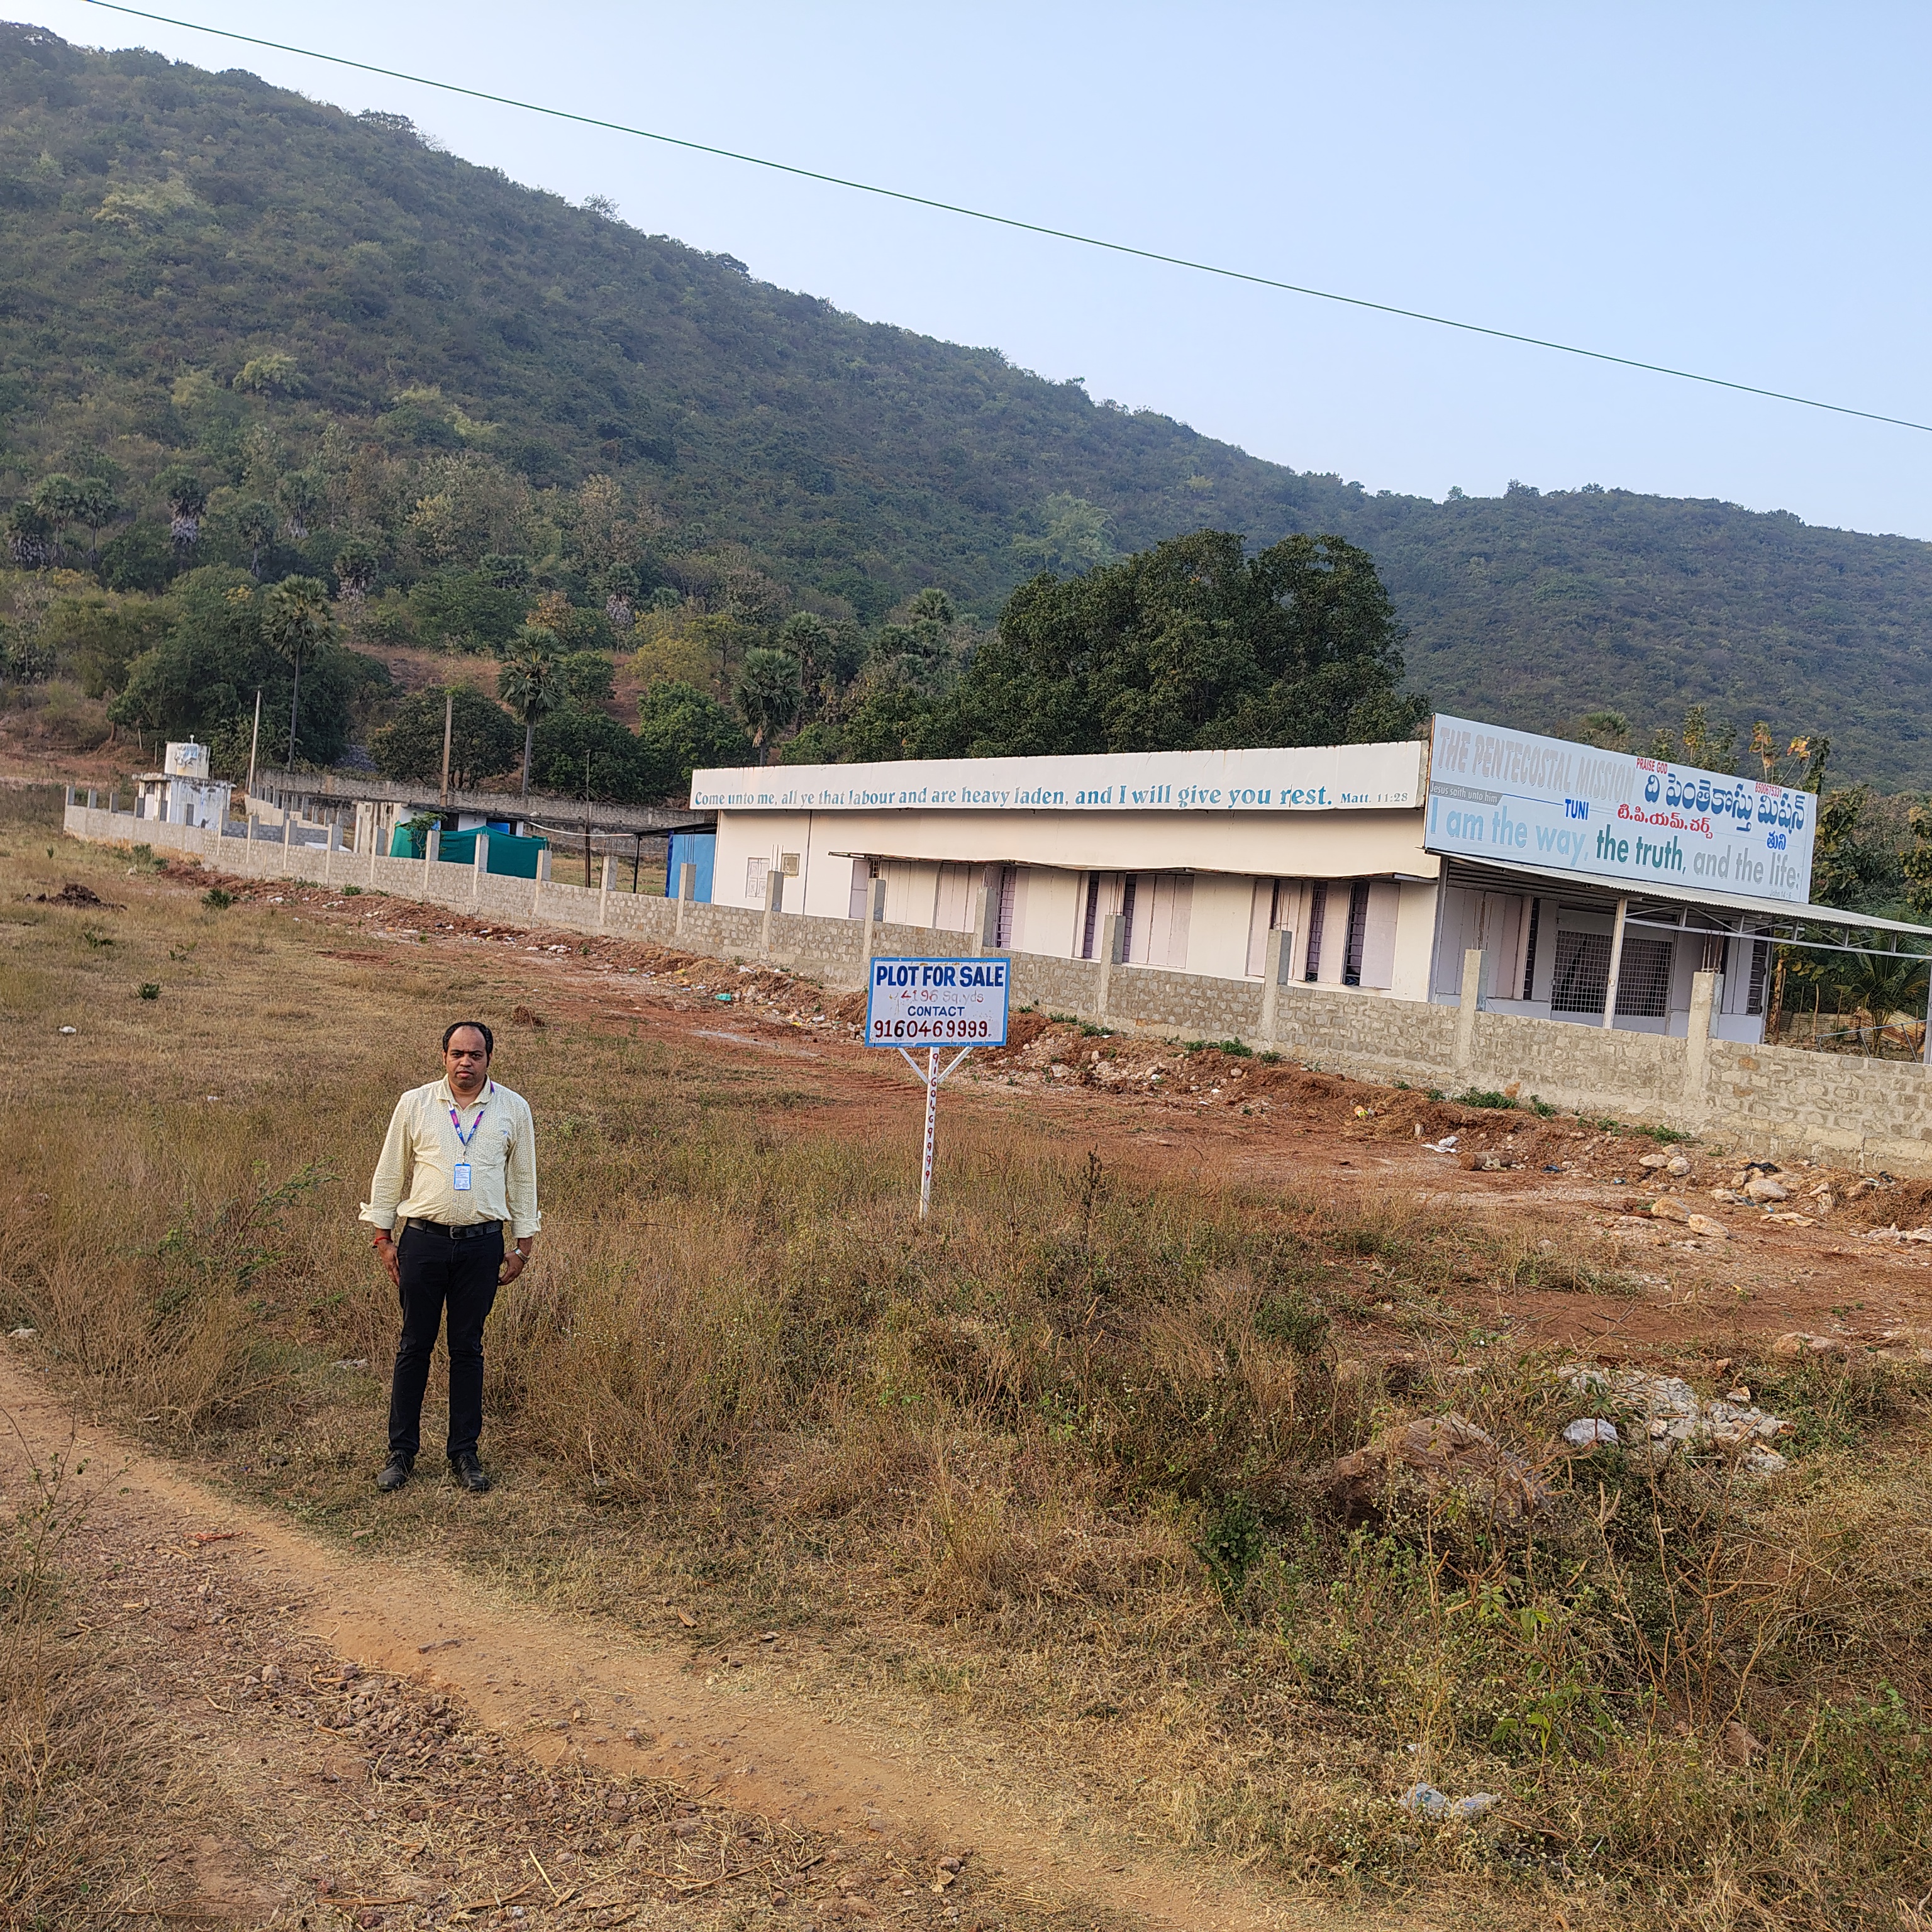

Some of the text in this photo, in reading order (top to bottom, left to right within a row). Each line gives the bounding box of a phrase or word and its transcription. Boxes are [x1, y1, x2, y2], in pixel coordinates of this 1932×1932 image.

[1438, 727, 1636, 804] THE PENTECOSTAL MISSION
[1636, 758, 1668, 774] PRAISE GOD
[695, 784, 1408, 809] Come unto me, all ye that labour and are heavy laden, and I will give you rest. Matt. 11:28
[1430, 782, 1497, 804] Jesus saith unto him
[1645, 774, 1660, 802] ది
[1565, 799, 1589, 821] TUNI
[1430, 797, 1439, 835] I
[1446, 810, 1484, 841] am
[1492, 806, 1528, 848] the
[1596, 824, 1629, 864] the
[1635, 835, 1687, 875] truth,
[1693, 845, 1731, 879] and
[1735, 847, 1765, 885] the
[1767, 831, 1787, 850] తుని
[876, 965, 1004, 987] PLOT FOR SALE
[908, 1006, 965, 1016] CONTACT
